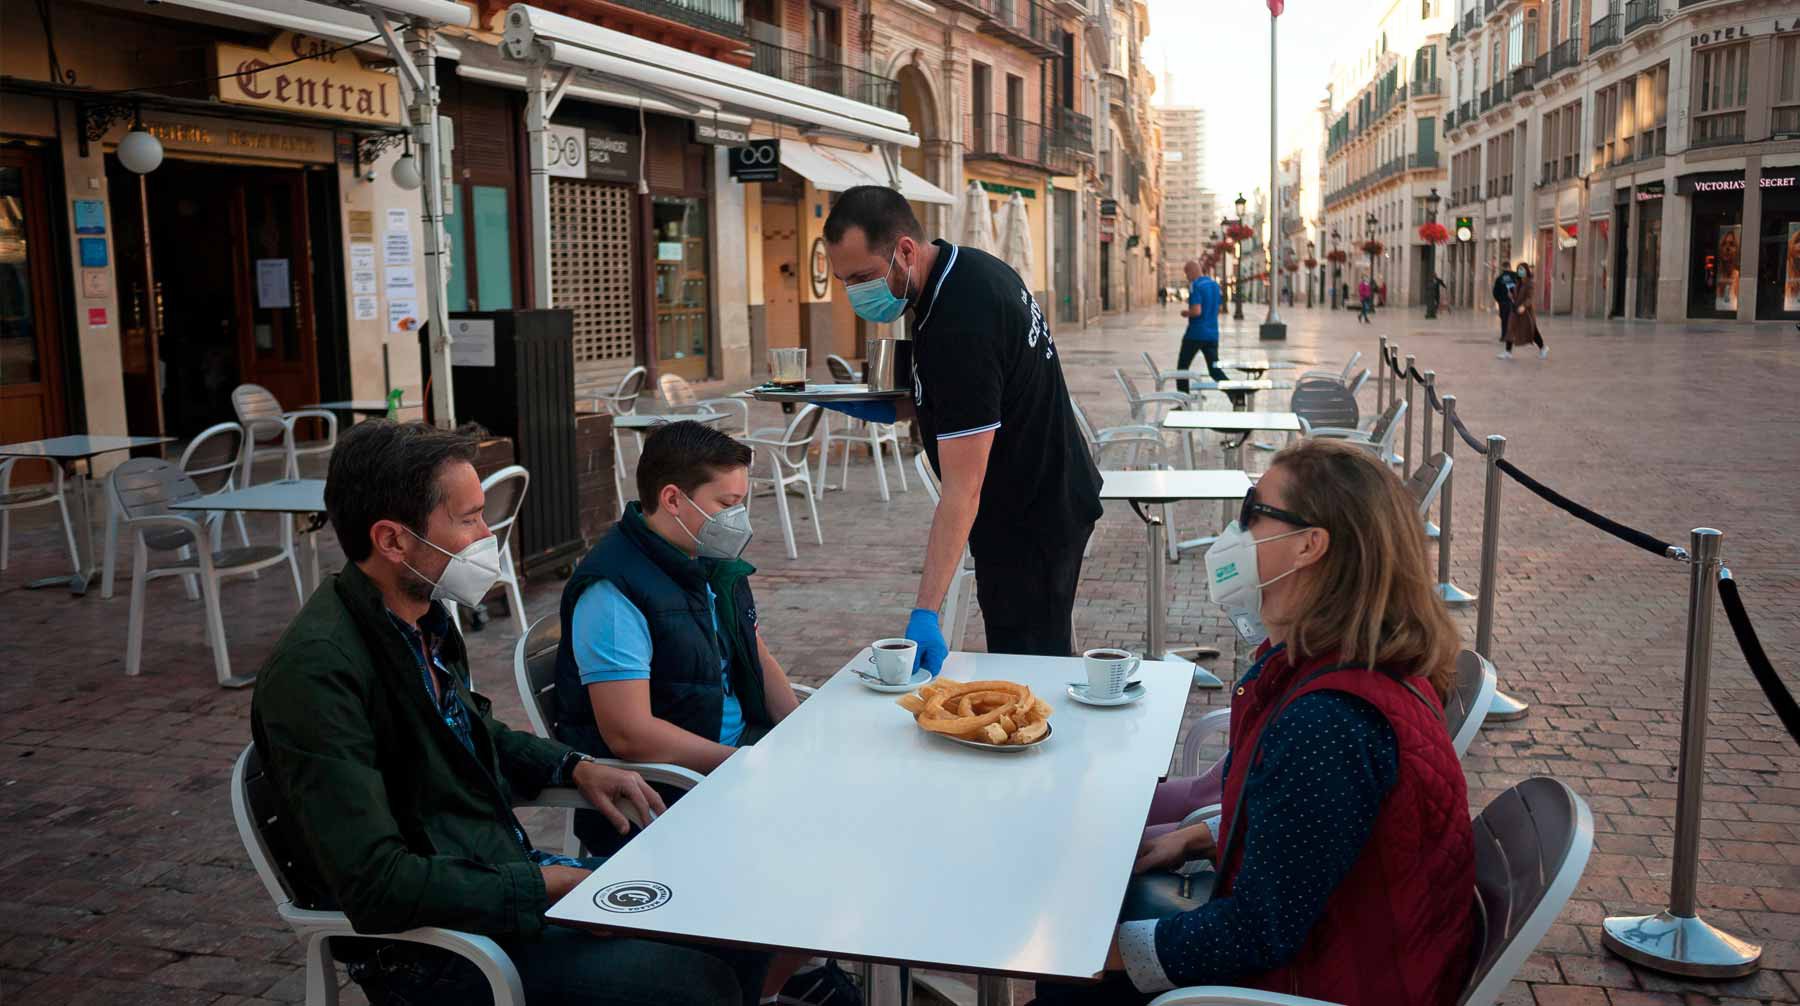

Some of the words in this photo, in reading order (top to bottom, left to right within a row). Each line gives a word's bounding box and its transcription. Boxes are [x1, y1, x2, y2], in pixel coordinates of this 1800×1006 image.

[1690, 25, 1749, 47] HOTEL
[236, 57, 389, 117] Central
[1694, 180, 1746, 192] VICTORIA'S
[1759, 177, 1796, 188] SECRET
